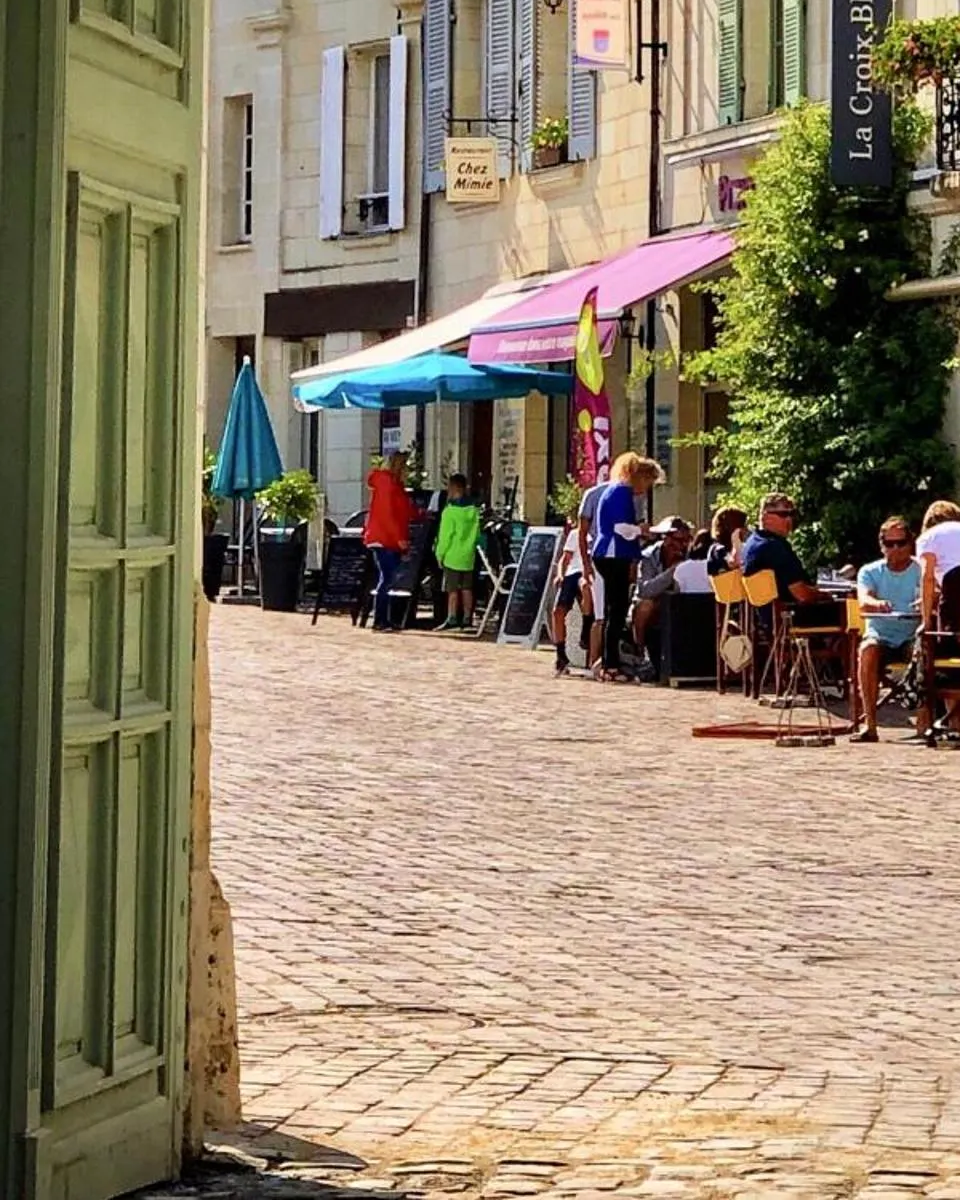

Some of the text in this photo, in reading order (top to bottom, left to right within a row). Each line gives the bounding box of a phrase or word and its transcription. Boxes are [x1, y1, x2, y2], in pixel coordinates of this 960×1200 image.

[849, 34, 873, 115] Croix
[849, 126, 872, 160] La
[457, 162, 488, 175] Chez
[453, 177, 493, 190] Mimie
